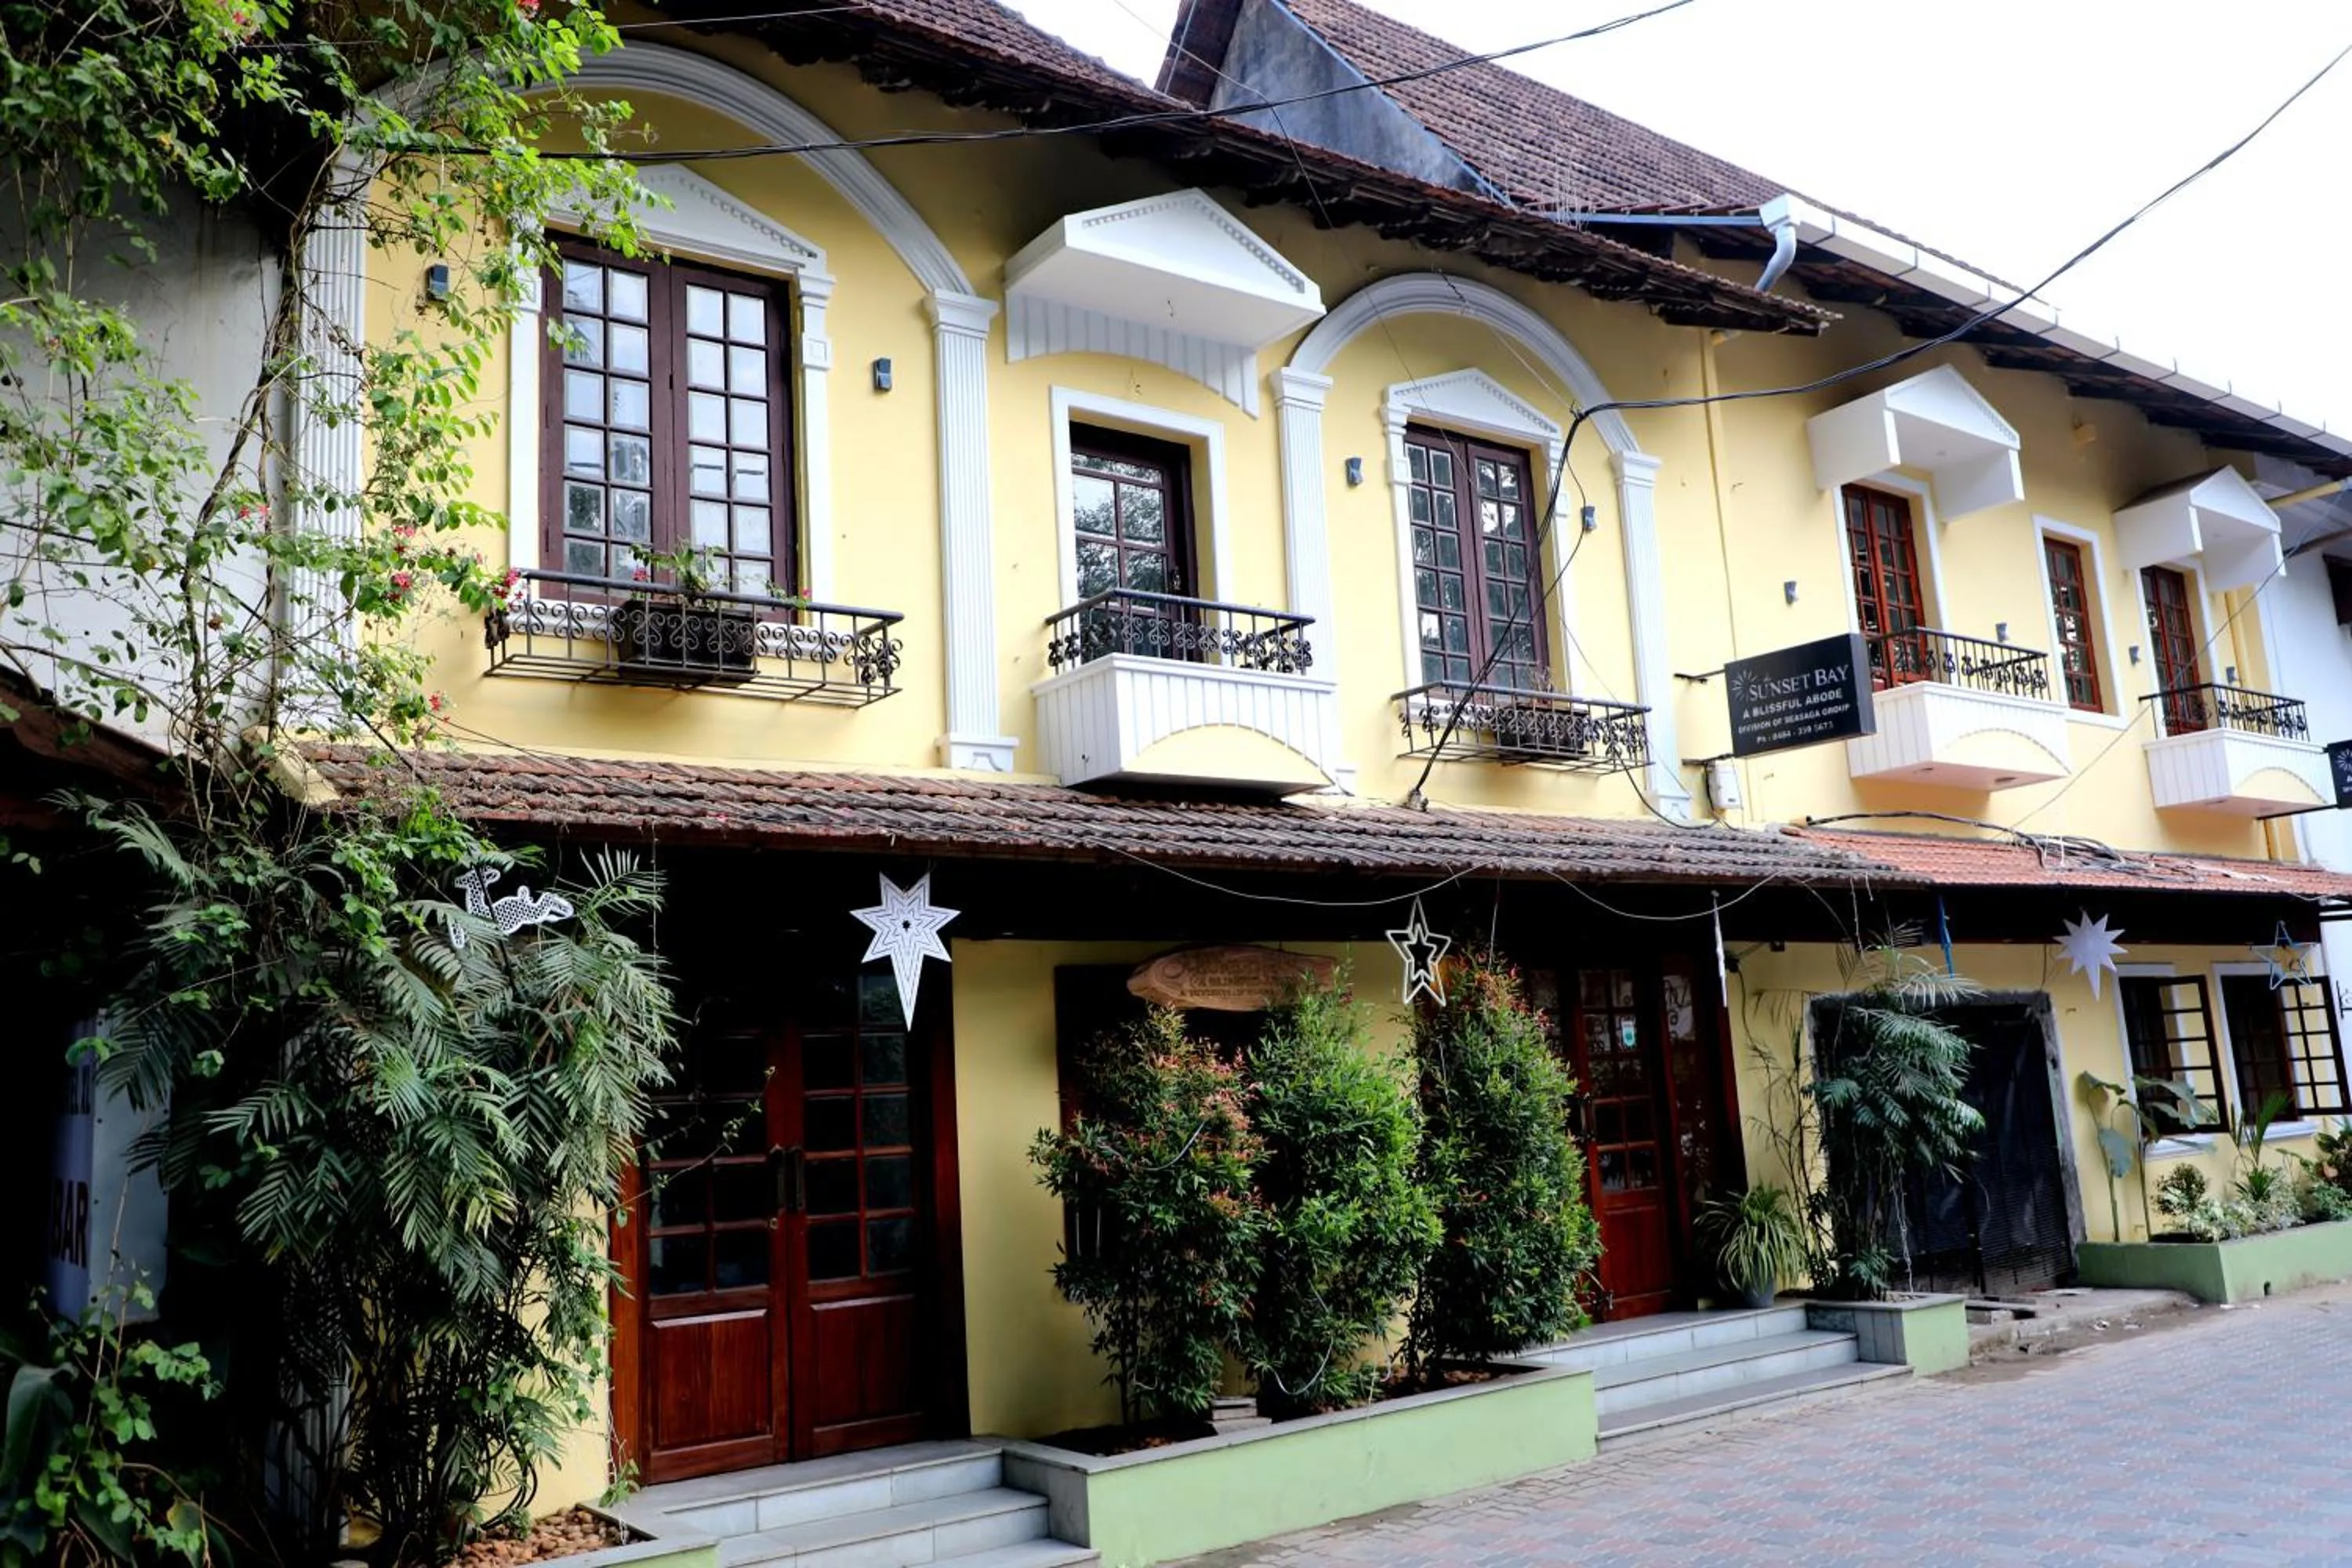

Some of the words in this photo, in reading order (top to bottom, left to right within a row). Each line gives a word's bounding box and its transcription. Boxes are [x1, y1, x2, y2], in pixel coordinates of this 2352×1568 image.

[1749, 673, 1810, 702] SUNSET
[1814, 664, 1849, 687] BAY
[1738, 720, 1771, 734] DIVISION
[1773, 718, 1783, 728] OF
[1821, 703, 1851, 716] GROUP
[1743, 709, 1750, 720] A
[1752, 699, 1802, 717] BLISSFUL
[1806, 688, 1843, 706] ABODE
